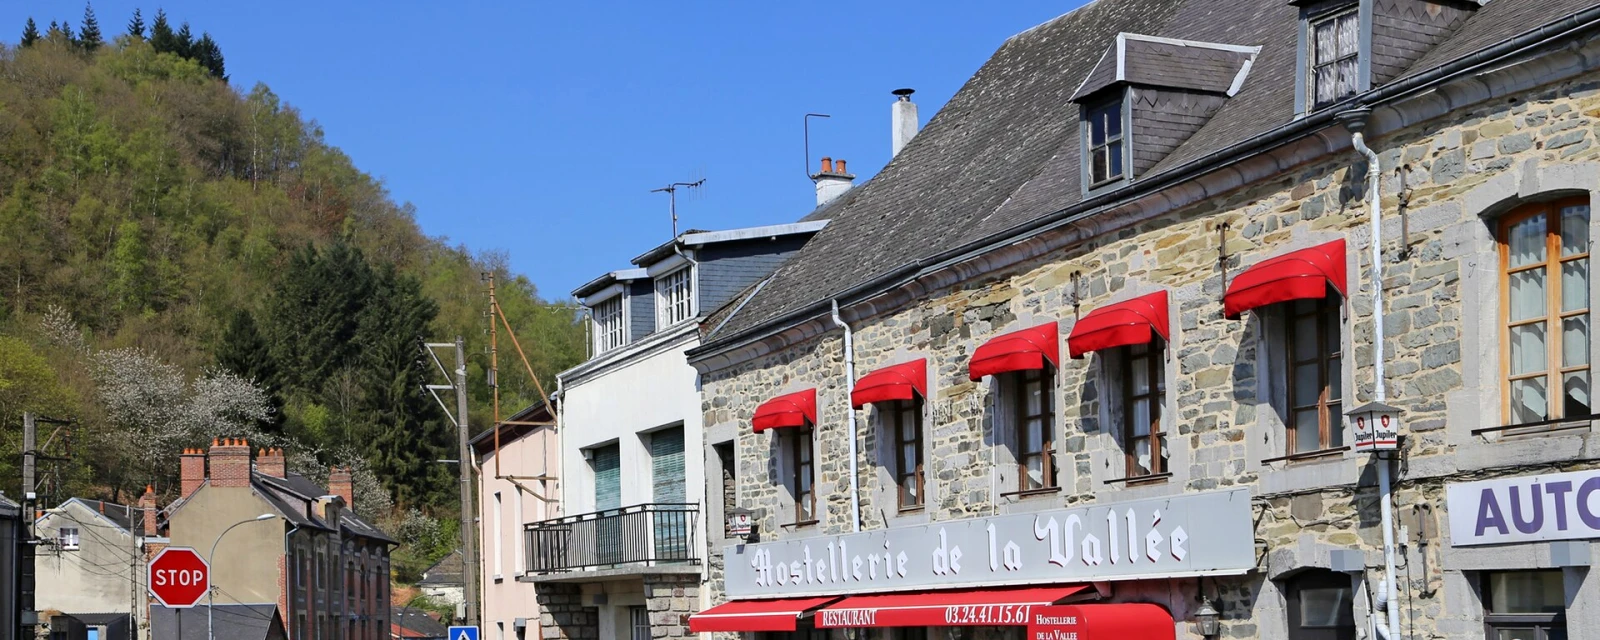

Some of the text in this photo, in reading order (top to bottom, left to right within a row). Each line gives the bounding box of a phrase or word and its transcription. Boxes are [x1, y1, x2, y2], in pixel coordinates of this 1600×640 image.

[1354, 431, 1373, 442] Jupiler
[1375, 429, 1397, 440] Jupiler
[751, 507, 1189, 587] Hostellerie de la Vallée
[155, 569, 203, 586] STOP
[822, 605, 1030, 626] RESTAURANT 03.24.41.15.61
[1036, 614, 1077, 625] HOSTELLERIE
